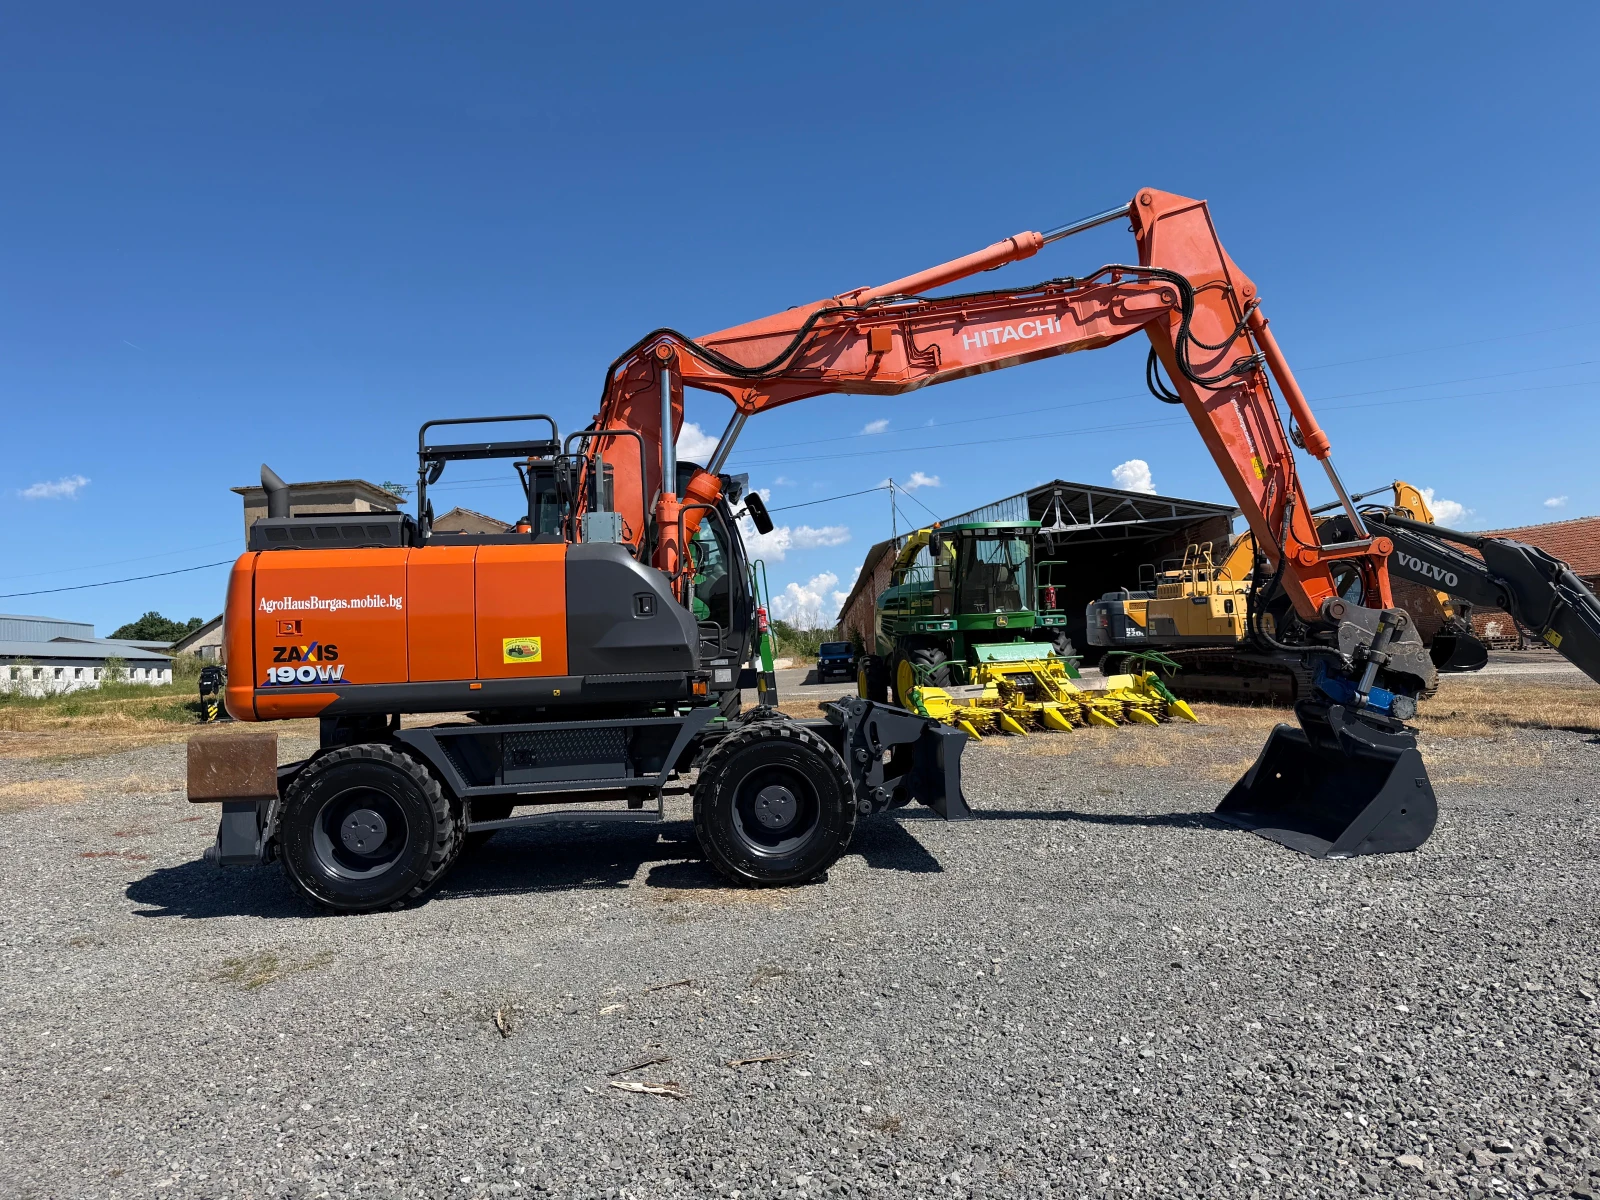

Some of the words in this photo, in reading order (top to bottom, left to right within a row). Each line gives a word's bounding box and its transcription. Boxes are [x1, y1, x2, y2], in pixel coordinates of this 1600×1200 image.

[962, 317, 1061, 350] HITACHI
[1396, 550, 1459, 587] VOLVO
[258, 594, 403, 614] AgroHausBurgas.mobile.bg
[273, 641, 339, 662] ZAXIS
[266, 664, 345, 684] 190W
